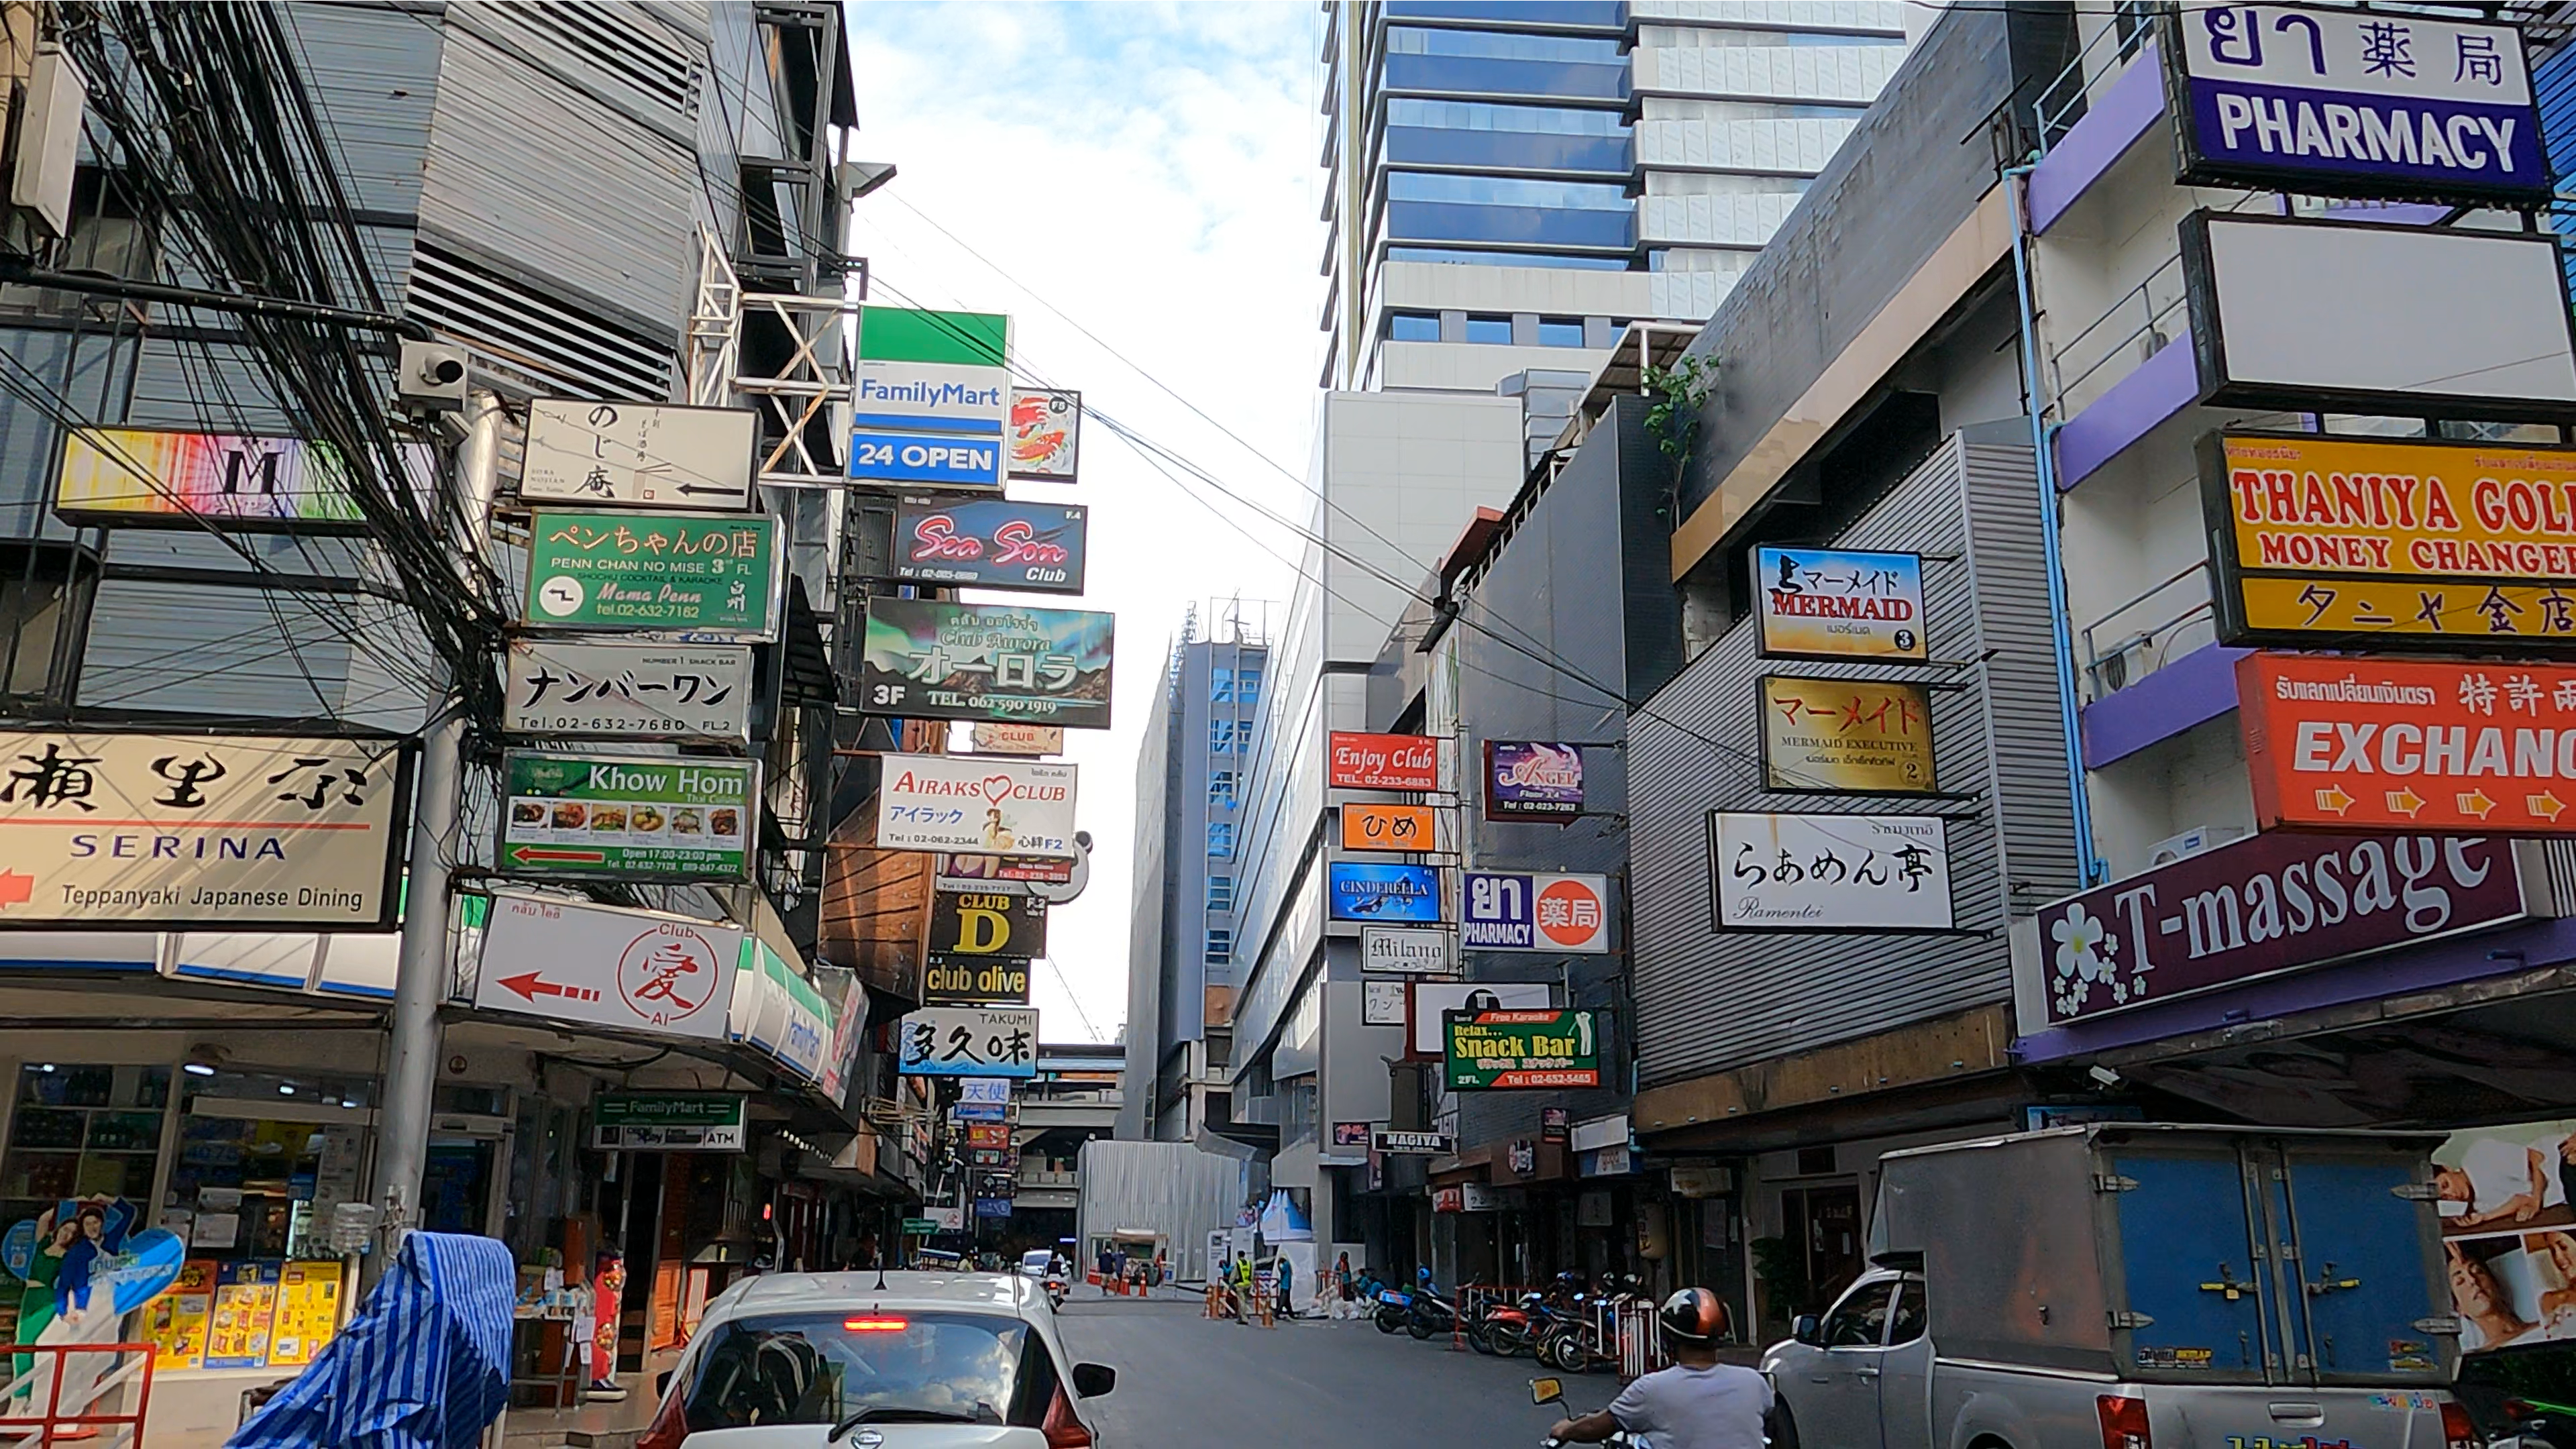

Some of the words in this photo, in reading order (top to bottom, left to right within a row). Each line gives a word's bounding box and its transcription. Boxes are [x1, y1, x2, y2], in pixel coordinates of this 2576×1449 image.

[2204, 8, 2328, 76] ยา
[2358, 21, 2502, 87] 薬局
[2216, 93, 2516, 172] PHARMACY
[861, 378, 1000, 407] FamilyMart
[858, 443, 894, 465] 24
[901, 445, 992, 470] OPEN
[222, 448, 284, 494] M
[2233, 471, 2459, 529] THANIYA
[549, 525, 757, 559] ペンちゃんの店
[912, 515, 983, 561] Sea
[991, 521, 1069, 566] Son
[2259, 533, 2390, 568] MONEY
[551, 557, 592, 570] PENN
[597, 559, 639, 571] CHAN
[643, 561, 665, 572] NO
[669, 562, 705, 574] MISE
[737, 563, 752, 576] FL
[1026, 567, 1067, 582] Club
[620, 574, 665, 583] COCKTAIL
[678, 576, 723, 585] KARAOKE
[1802, 570, 1899, 595] マーメイド
[596, 582, 651, 602] Mama
[657, 583, 702, 603] Penn
[1770, 593, 1913, 622] MERMAID
[951, 615, 980, 627] คลับ
[941, 629, 983, 646] Club
[986, 632, 1051, 651] Aurora
[1899, 631, 1911, 646] 3
[908, 646, 1081, 691] オーロラ
[522, 665, 733, 708] ナンバーワン
[873, 685, 906, 705] 3F
[2276, 674, 2436, 705] รับแลกเปลี่ยนเงินตรา
[927, 691, 965, 707] TEL.
[967, 696, 996, 709] 062
[998, 698, 1024, 712] 590
[1026, 700, 1057, 714] 1919
[1773, 695, 1921, 735] マーメイド
[1001, 732, 1035, 741] CLUB
[1781, 737, 1843, 749] MERMAID
[1845, 739, 1917, 752] EXECUTIVE
[1336, 747, 1387, 774] Enjoy
[1391, 747, 1433, 769] Club
[1906, 762, 1918, 780] 2
[588, 764, 667, 793] Khow
[677, 769, 743, 795] Hom
[893, 771, 981, 798] AIRAKS
[1012, 785, 1066, 801] CLUB
[1336, 773, 1362, 784] TEL.
[686, 793, 706, 803] Thai
[890, 805, 963, 824] アイラック
[889, 833, 905, 843] Tel
[1362, 815, 1417, 839] ひめ
[70, 835, 286, 861] SERINA
[622, 848, 647, 860] Open
[1044, 839, 1063, 851] F2
[1733, 841, 1933, 893] らあめん亭
[62, 883, 180, 906] Teppanyaki
[190, 886, 288, 908] Japanese
[297, 887, 363, 912] Dining
[1340, 880, 1429, 896] CINDERELLA
[1472, 877, 1521, 920] ยา
[958, 894, 1010, 910] CLUB
[1540, 898, 1599, 929] 薬局
[1732, 896, 1824, 920] Ramentei
[2114, 837, 2491, 973] T-massage
[659, 922, 695, 938] Club
[953, 908, 1010, 953] D
[1464, 922, 1531, 945] PHARMACY
[1371, 938, 1442, 958] Milano
[634, 943, 699, 1010] 愛
[927, 964, 973, 991] club
[977, 965, 1026, 994] olive
[979, 1013, 1033, 1026] TAKUMI
[1490, 1013, 1511, 1022] Free
[1511, 1013, 1549, 1022] Karaoke
[906, 1024, 1032, 1067] 多久味
[1454, 1035, 1525, 1059] Snack
[1532, 1035, 1576, 1057] Bar
[1507, 1074, 1523, 1084] Tel
[965, 1083, 1006, 1102] 天使
[629, 1101, 704, 1115] FamilyMart
[707, 1132, 735, 1144] ATM
[1386, 1134, 1442, 1147] NAGIYA
